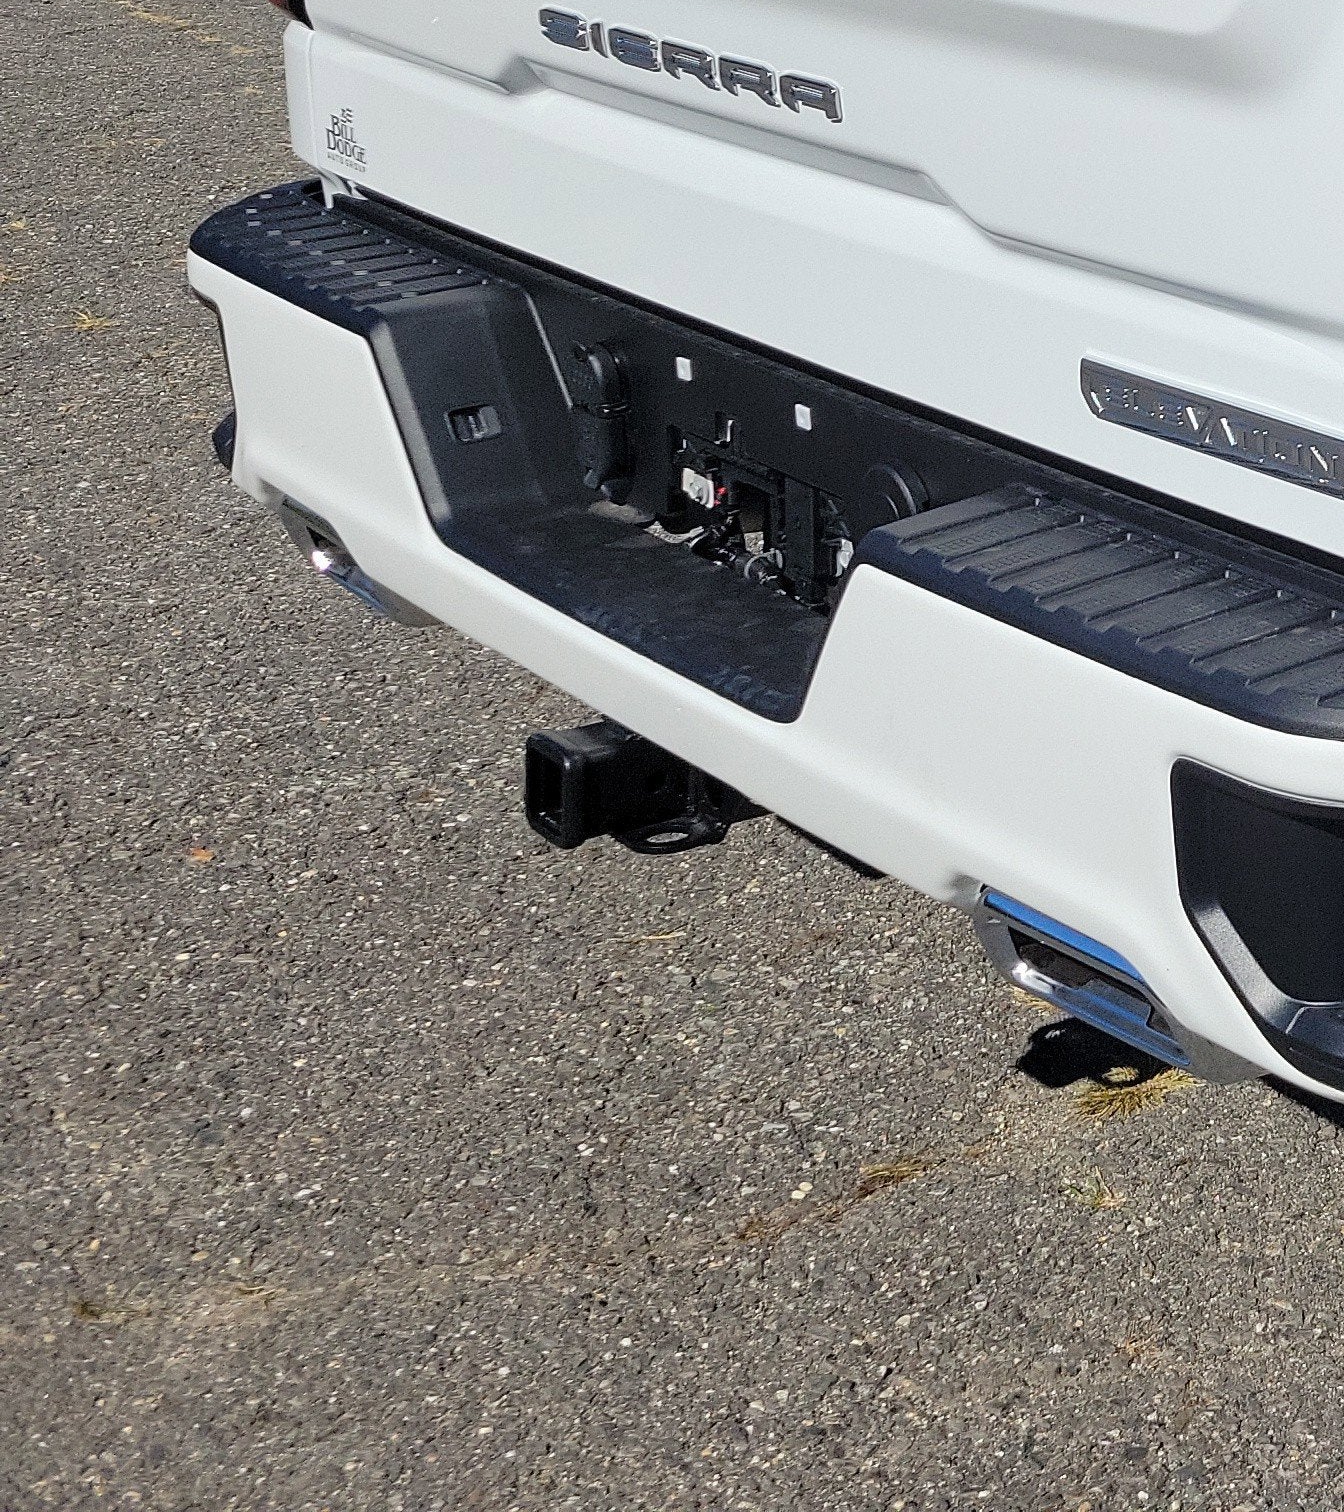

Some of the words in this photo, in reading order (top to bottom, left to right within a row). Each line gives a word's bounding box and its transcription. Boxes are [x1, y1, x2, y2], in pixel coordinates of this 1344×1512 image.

[538, 6, 843, 123] SIERRA
[325, 127, 366, 164] DODGE
[330, 114, 356, 144] BILL
